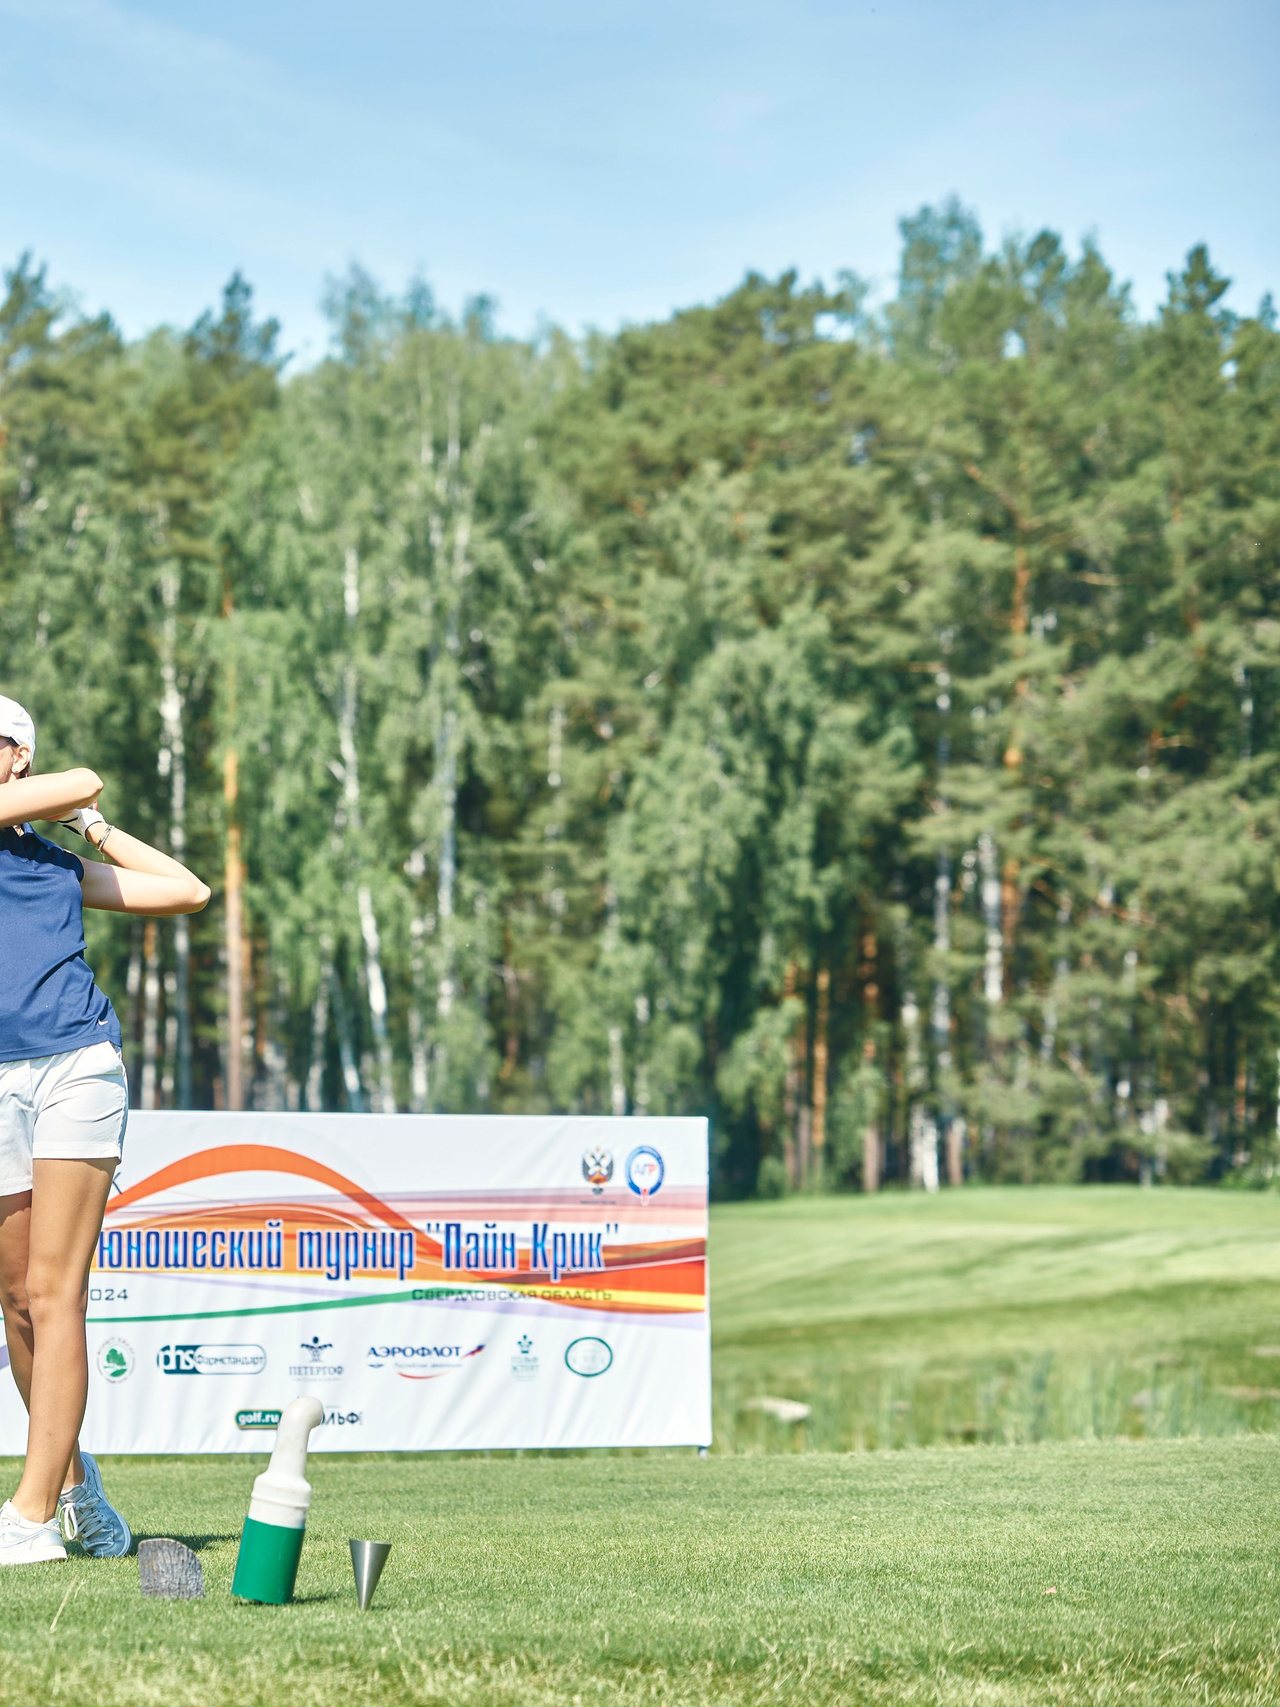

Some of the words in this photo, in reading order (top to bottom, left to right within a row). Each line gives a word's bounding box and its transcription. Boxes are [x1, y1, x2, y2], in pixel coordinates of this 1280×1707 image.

[298, 1231, 415, 1281] турнир
[90, 1289, 128, 1300] 024
[367, 1346, 461, 1358] АЭРОФЛОТ
[289, 1366, 344, 1377] ПЕТЕРГОФ
[238, 1411, 280, 1426] golf.ru
[322, 1412, 359, 1425] ЛЬФ
